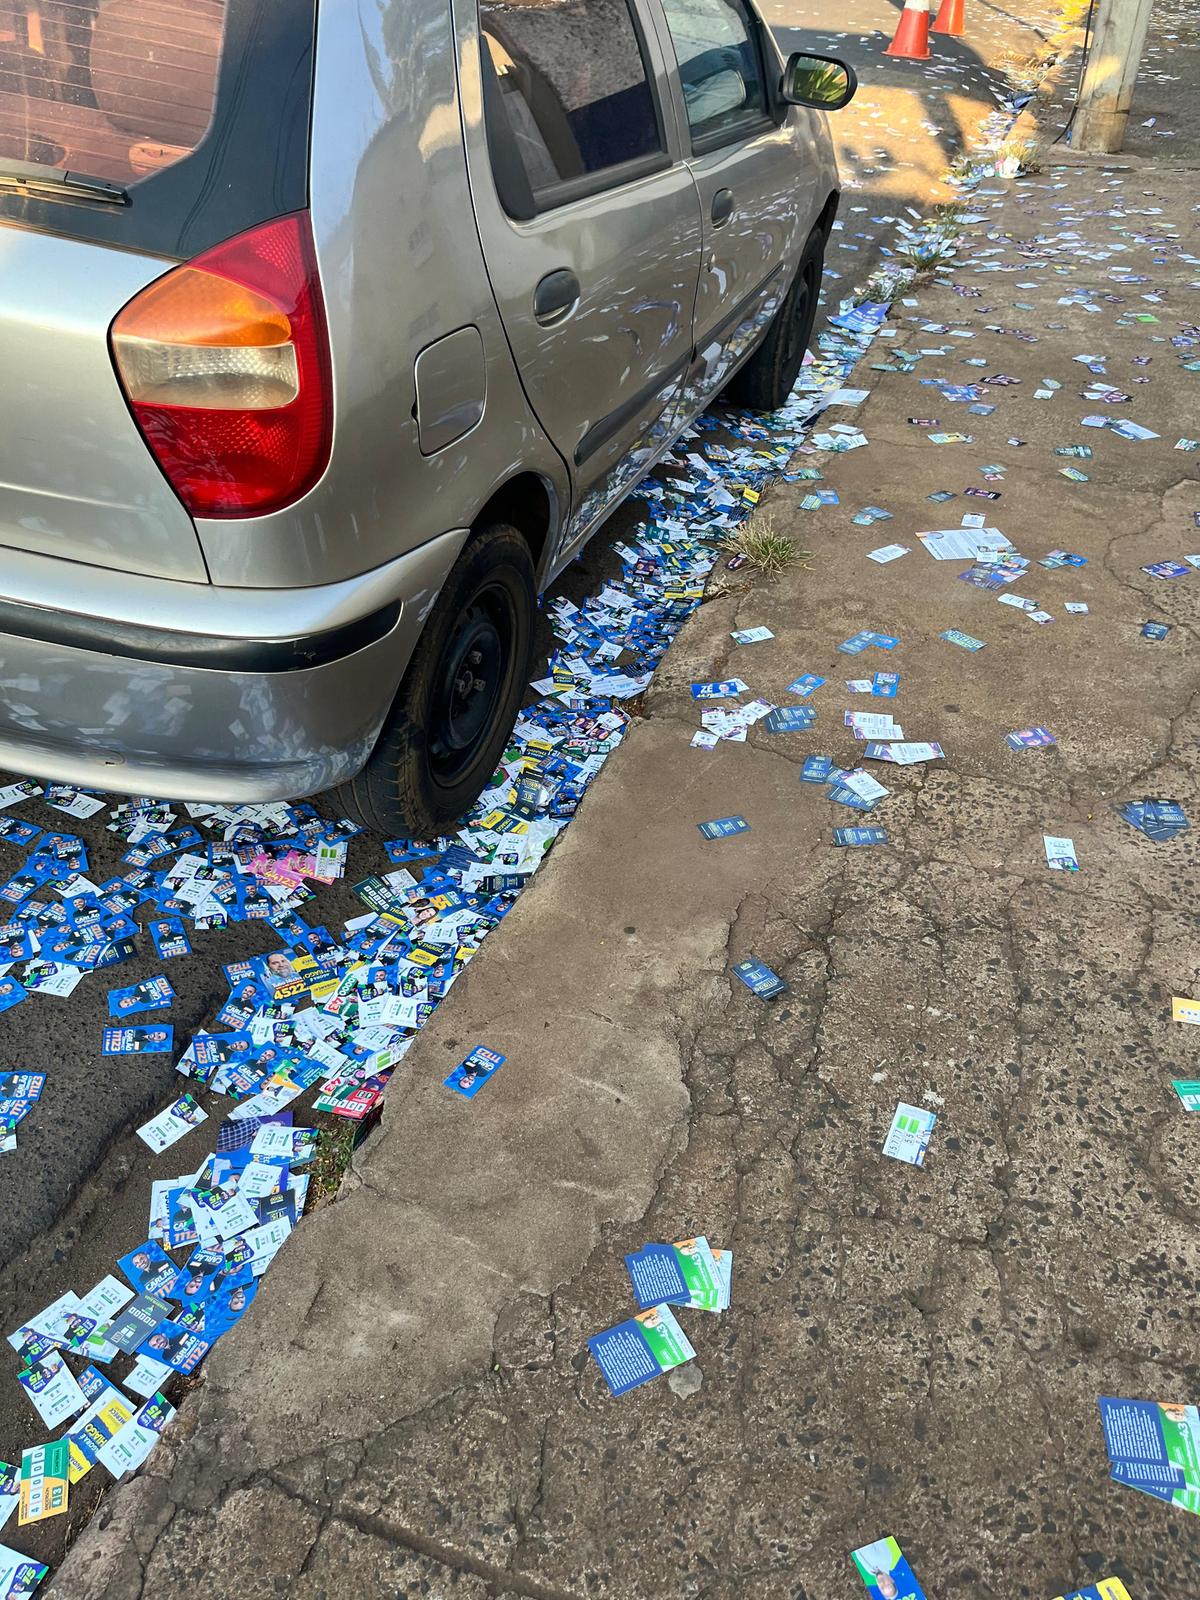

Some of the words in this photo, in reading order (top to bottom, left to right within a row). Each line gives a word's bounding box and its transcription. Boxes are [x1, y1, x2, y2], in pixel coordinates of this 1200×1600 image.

[700, 684, 713, 694] ZÉ
[266, 870, 297, 888] 44123
[244, 902, 269, 911] CARLÃO
[74, 914, 100, 924] CARLÃO
[246, 910, 270, 919] 11123
[159, 940, 186, 951] CARLÃO
[162, 947, 188, 958] 11123
[228, 962, 252, 972] 11123
[328, 997, 344, 1012] 43
[226, 1006, 250, 1020] CARLÃO
[220, 1014, 246, 1029] 11123
[110, 1030, 122, 1051] 11123
[195, 1042, 208, 1064] 11123
[206, 1040, 219, 1063] CARLÃO
[476, 1048, 501, 1063] 11123
[470, 1056, 495, 1070] CARLÃO
[238, 1064, 260, 1081] CARLÃO
[16, 1074, 28, 1098] CARLÃO
[28, 1076, 43, 1098] 11123
[324, 1077, 342, 1092] 43
[178, 1102, 190, 1114] 15
[302, 1132, 310, 1142] 15
[208, 1192, 221, 1204] 15
[194, 1252, 224, 1264] CARLÃO
[234, 1252, 244, 1262] 15
[145, 1267, 175, 1292] CARLÃO
[73, 1324, 88, 1338] 15
[28, 1342, 42, 1356] 15
[171, 1336, 196, 1366] CARLÃO
[182, 1340, 208, 1370] 11123
[29, 1372, 43, 1384] 15
[147, 1404, 162, 1418] 15
[24, 1566, 36, 1586] 15
